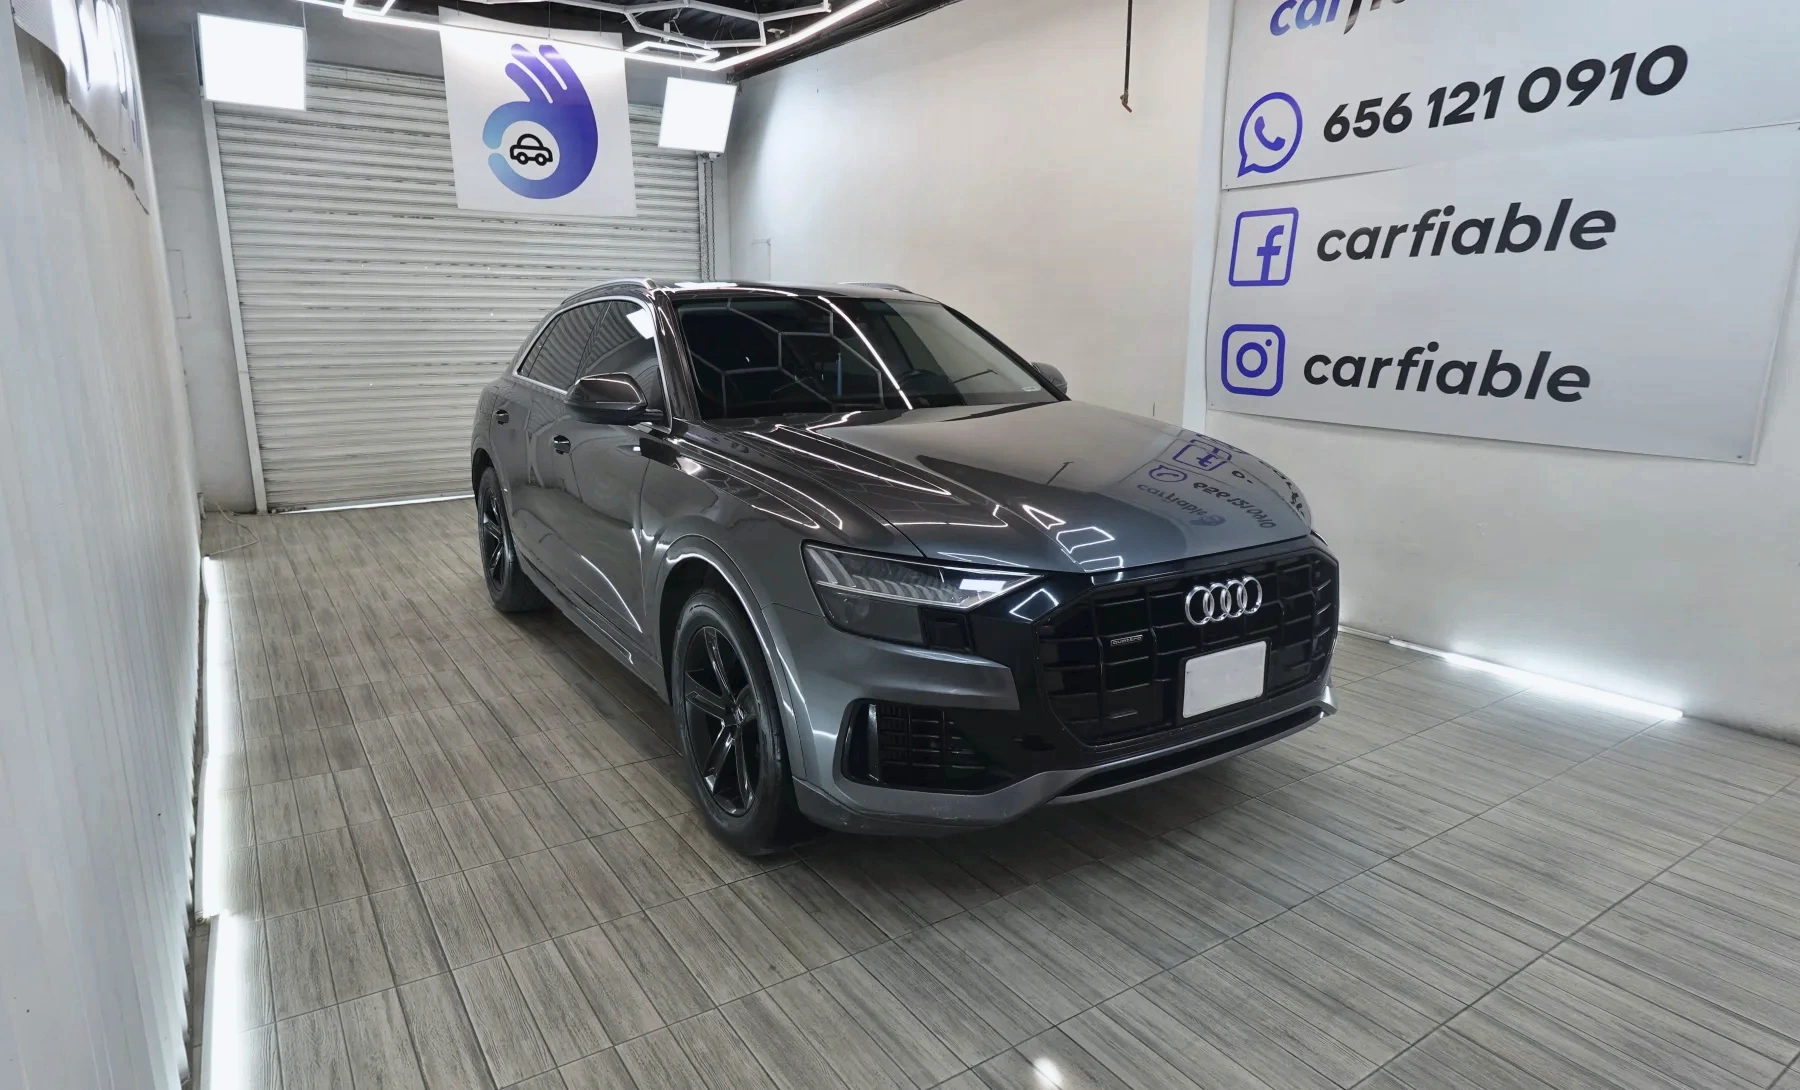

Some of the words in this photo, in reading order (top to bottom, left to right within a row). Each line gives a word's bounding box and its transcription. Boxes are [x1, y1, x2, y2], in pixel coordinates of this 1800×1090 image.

[1323, 92, 1413, 143] 656
[1427, 76, 1506, 129] 121
[1517, 44, 1689, 114] 0910
[1316, 198, 1617, 262] carfiable
[1303, 341, 1592, 403] carfiable
